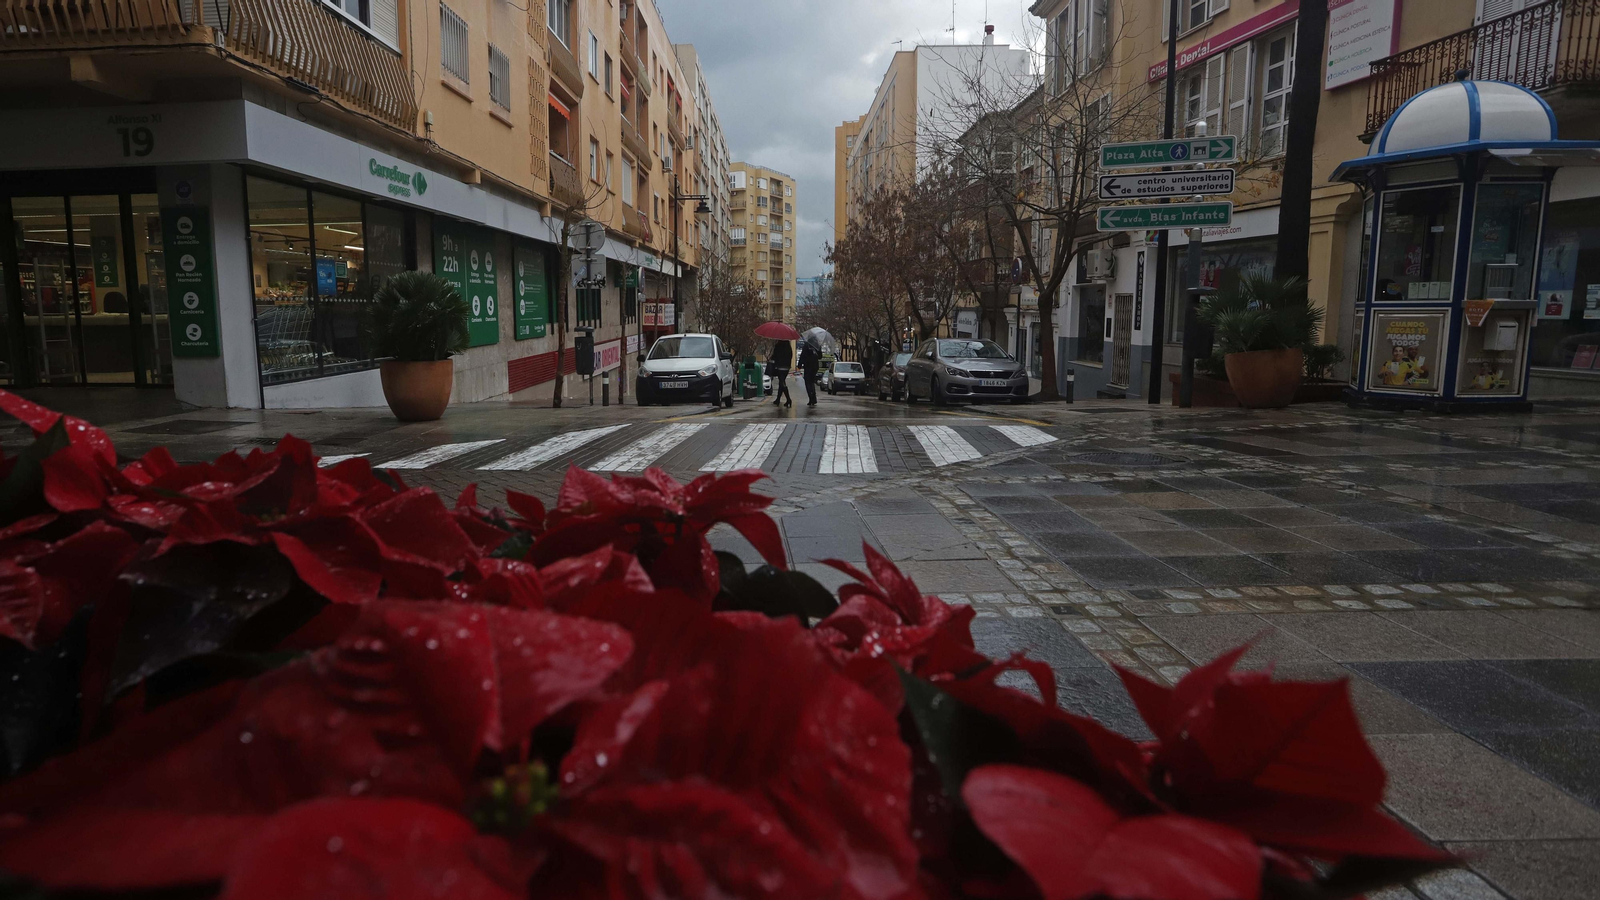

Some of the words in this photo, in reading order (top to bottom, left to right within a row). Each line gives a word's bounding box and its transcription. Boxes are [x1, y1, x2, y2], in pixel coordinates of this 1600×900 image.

[1350, 33, 1371, 45] MEDICINA
[1180, 42, 1211, 67] Dental
[108, 114, 149, 125] Alfonso
[151, 113, 163, 123] XI
[117, 126, 154, 157] 19
[1106, 150, 1135, 161] Plaza
[1139, 147, 1163, 160] Alta
[369, 157, 411, 186] Carrefour
[1120, 187, 1132, 195] de
[1136, 183, 1175, 194] estudios
[1180, 180, 1229, 193] superiores
[1137, 178, 1166, 187] centro
[1171, 173, 1230, 184] universitario
[387, 183, 411, 198] express
[1150, 211, 1177, 222] Blas
[1181, 208, 1226, 221] Infante
[442, 234, 454, 251] 9h
[454, 244, 459, 252] a
[442, 255, 459, 273] 22h
[1386, 333, 1427, 341] JUGAMOS
